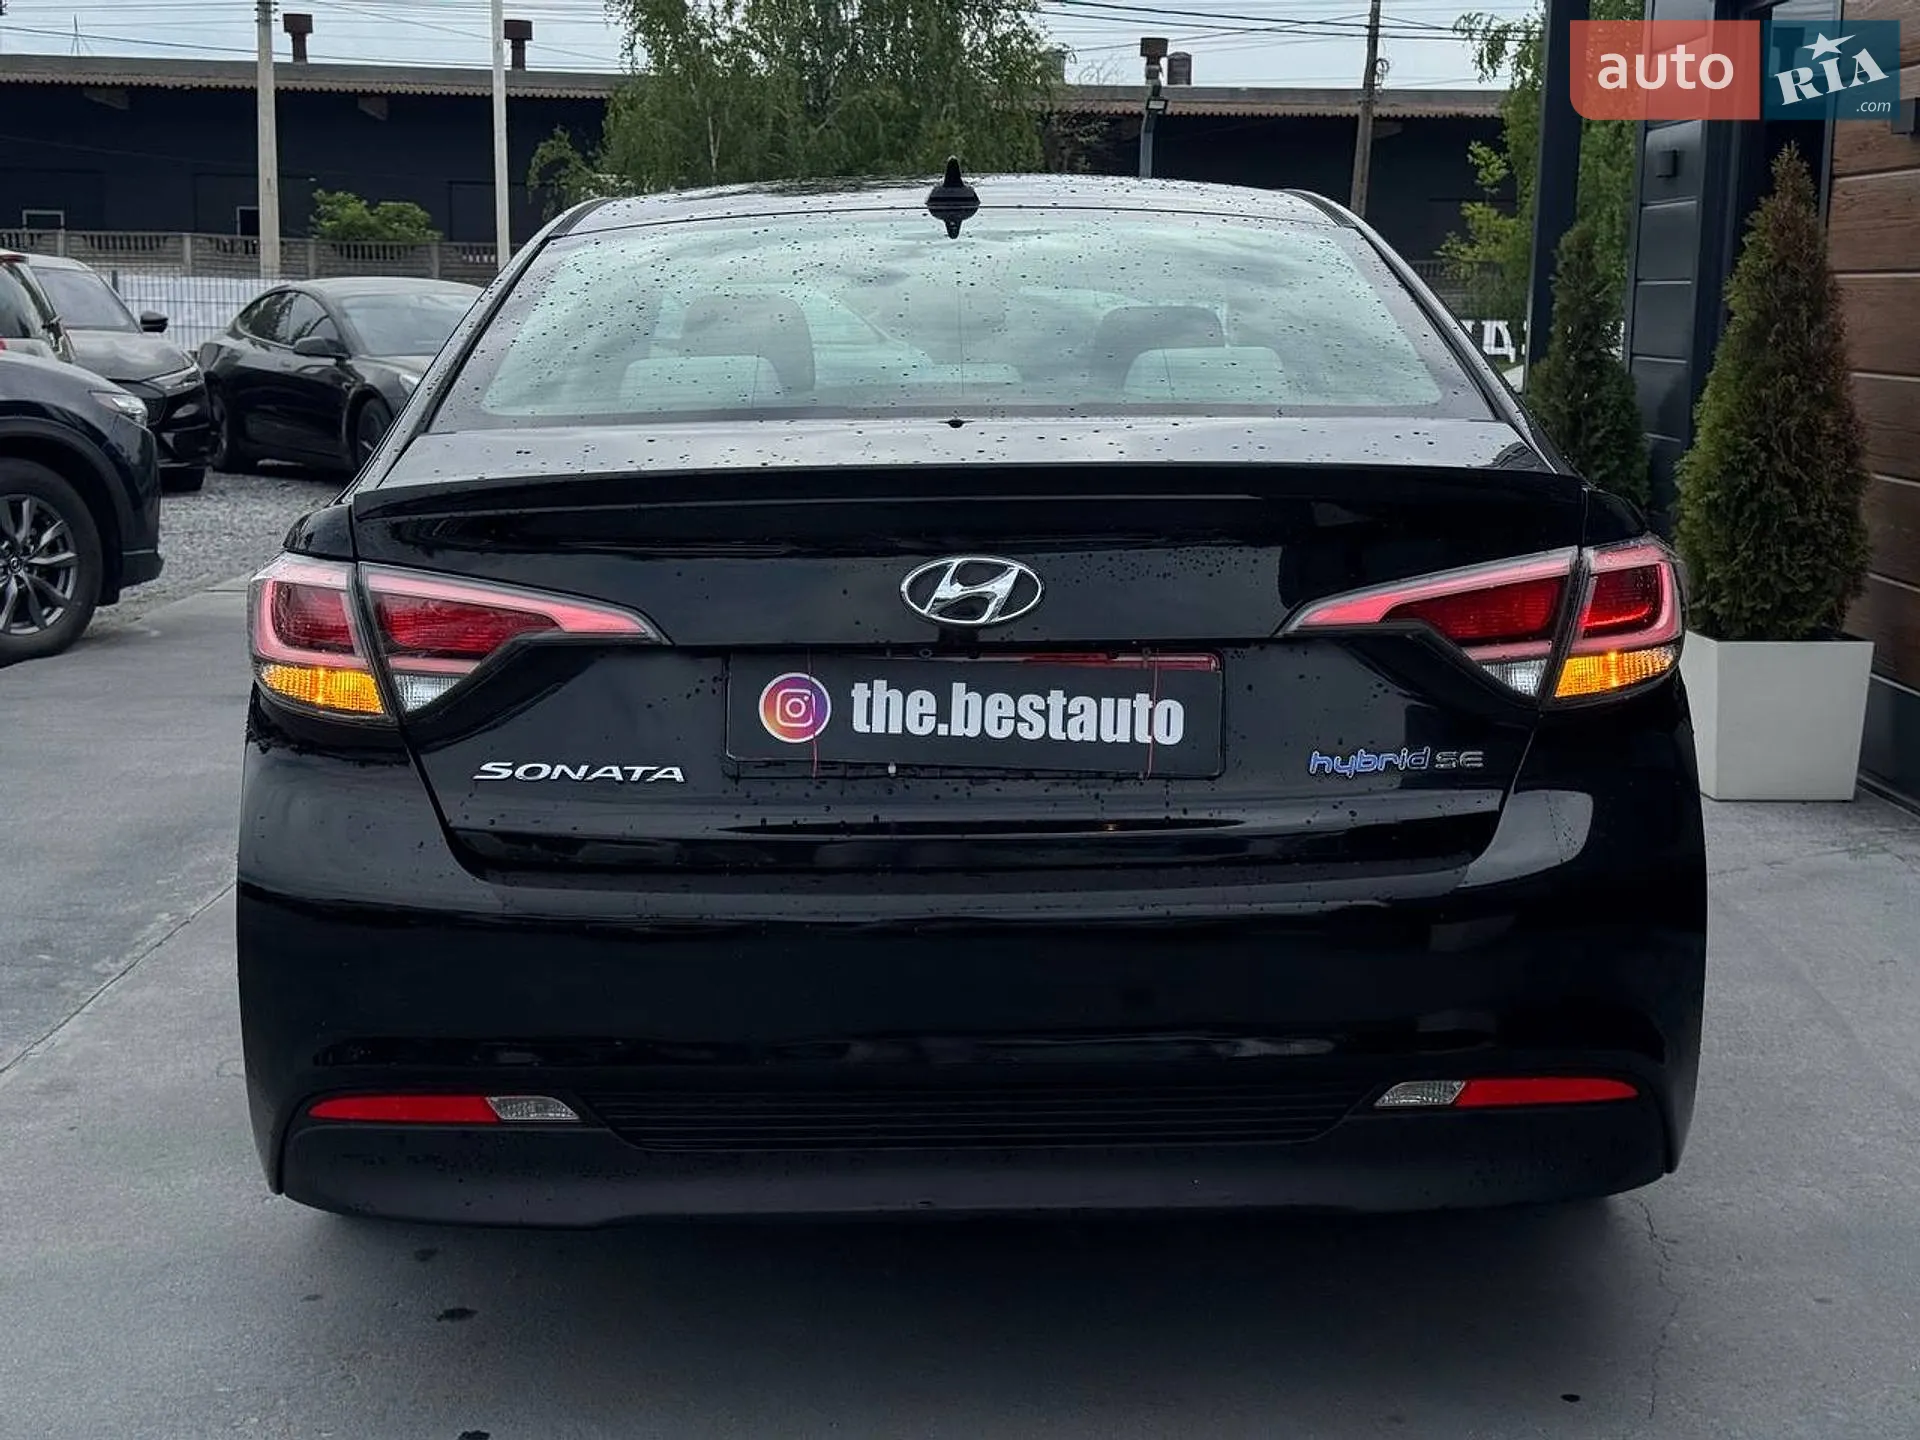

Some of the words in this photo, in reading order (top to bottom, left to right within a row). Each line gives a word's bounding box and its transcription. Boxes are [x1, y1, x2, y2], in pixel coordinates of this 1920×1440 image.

[851, 679, 1186, 746] the.bestauto
[473, 762, 685, 783] SONATA
[1310, 746, 1431, 779] hybrid
[1435, 751, 1484, 769] SE
